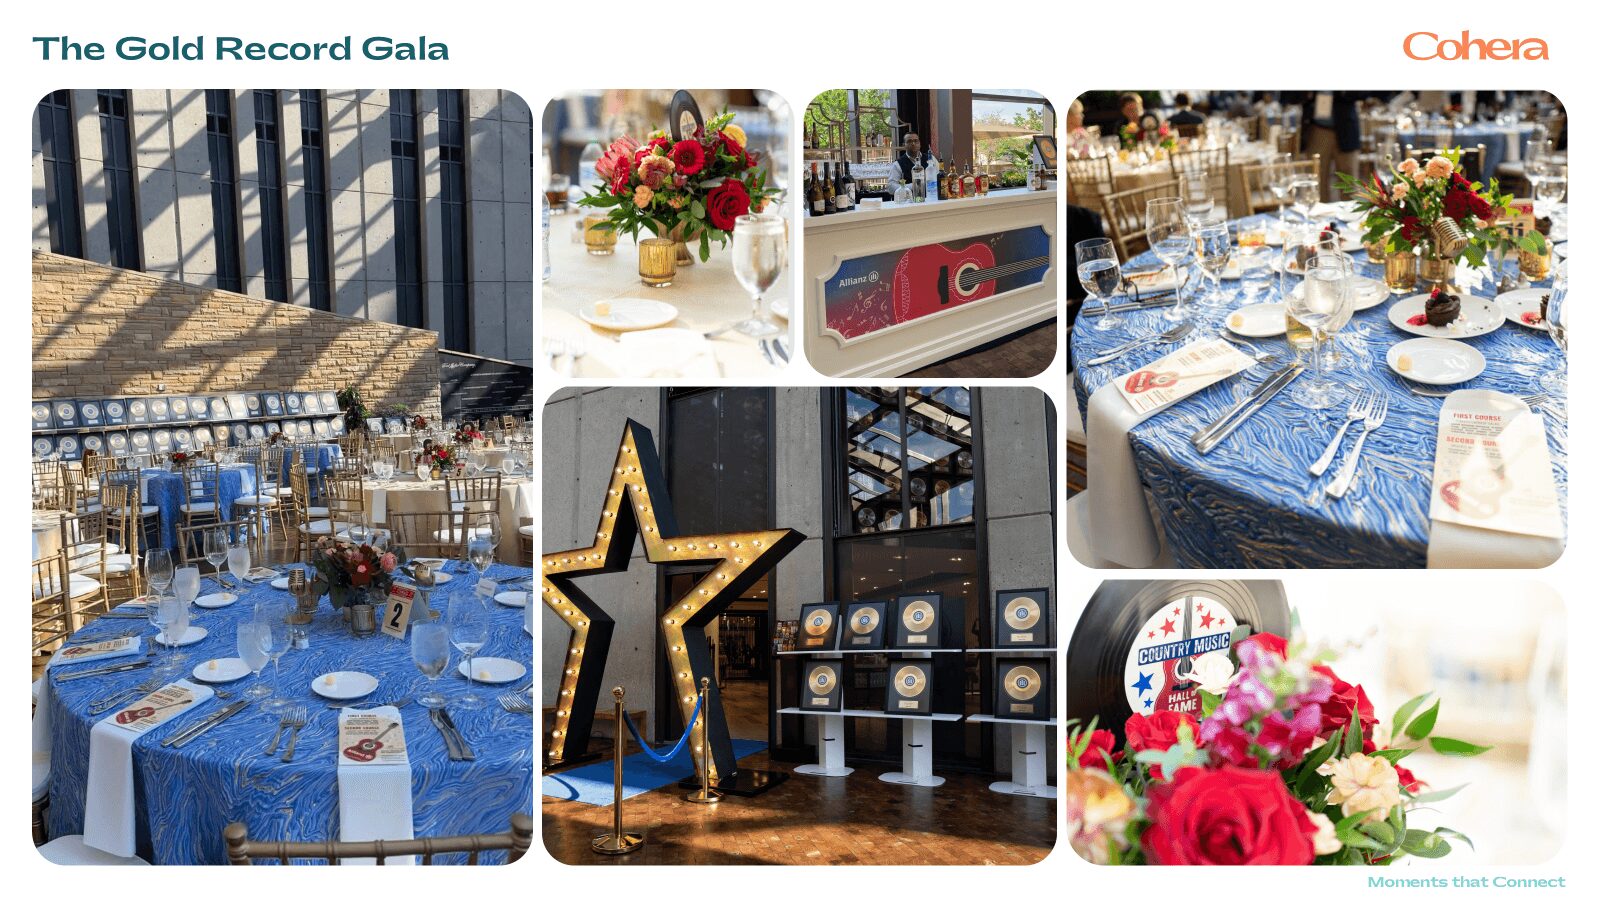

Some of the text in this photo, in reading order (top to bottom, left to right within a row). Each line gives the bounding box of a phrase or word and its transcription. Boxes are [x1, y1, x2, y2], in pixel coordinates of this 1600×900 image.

[839, 276, 867, 288] Allianz
[1453, 412, 1501, 422] FIRST COURSE
[390, 603, 403, 628] 2
[1140, 634, 1229, 664] COUNTRY MUSIC
[1168, 690, 1190, 703] HALL
[1168, 698, 1197, 712] FAME
